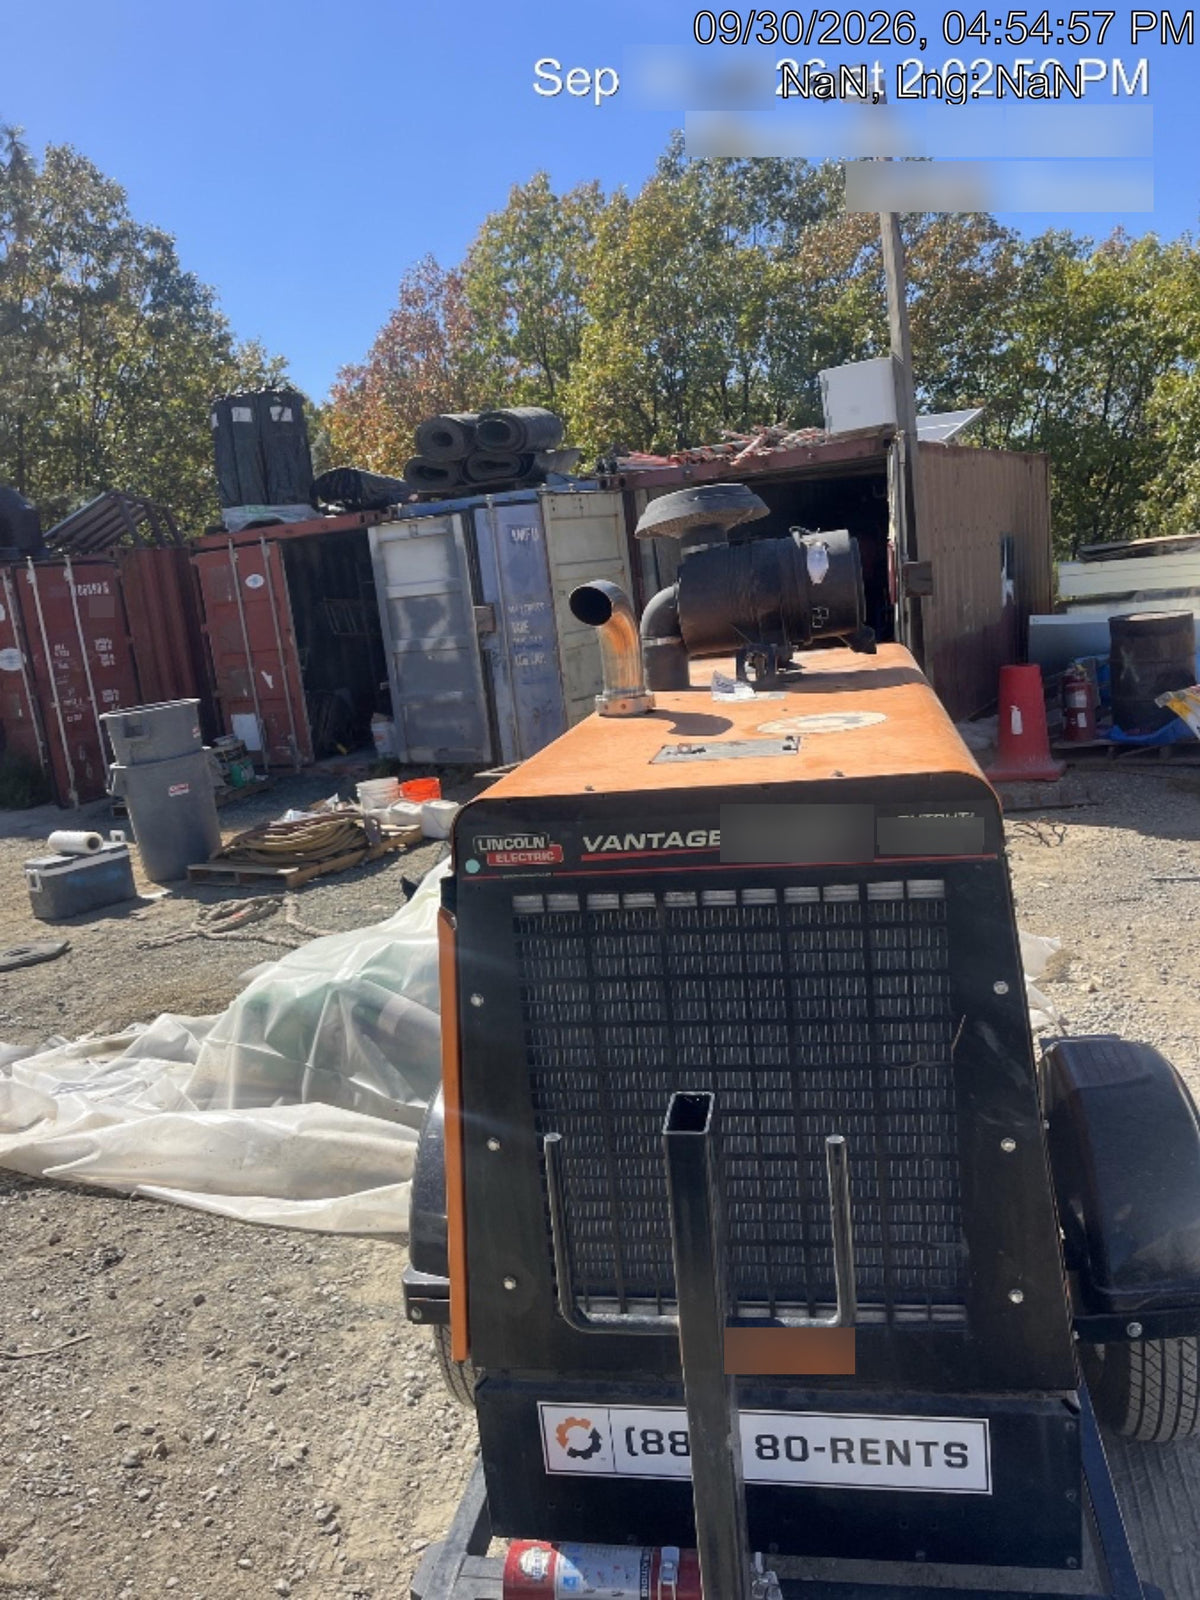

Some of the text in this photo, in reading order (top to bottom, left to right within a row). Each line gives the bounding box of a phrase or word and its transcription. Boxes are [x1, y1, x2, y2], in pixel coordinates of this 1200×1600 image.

[477, 836, 546, 851] LINCOLN
[582, 830, 721, 852] VANTAGE
[495, 850, 556, 863] ELECTRIC
[754, 1433, 969, 1469] 80-RENTS
